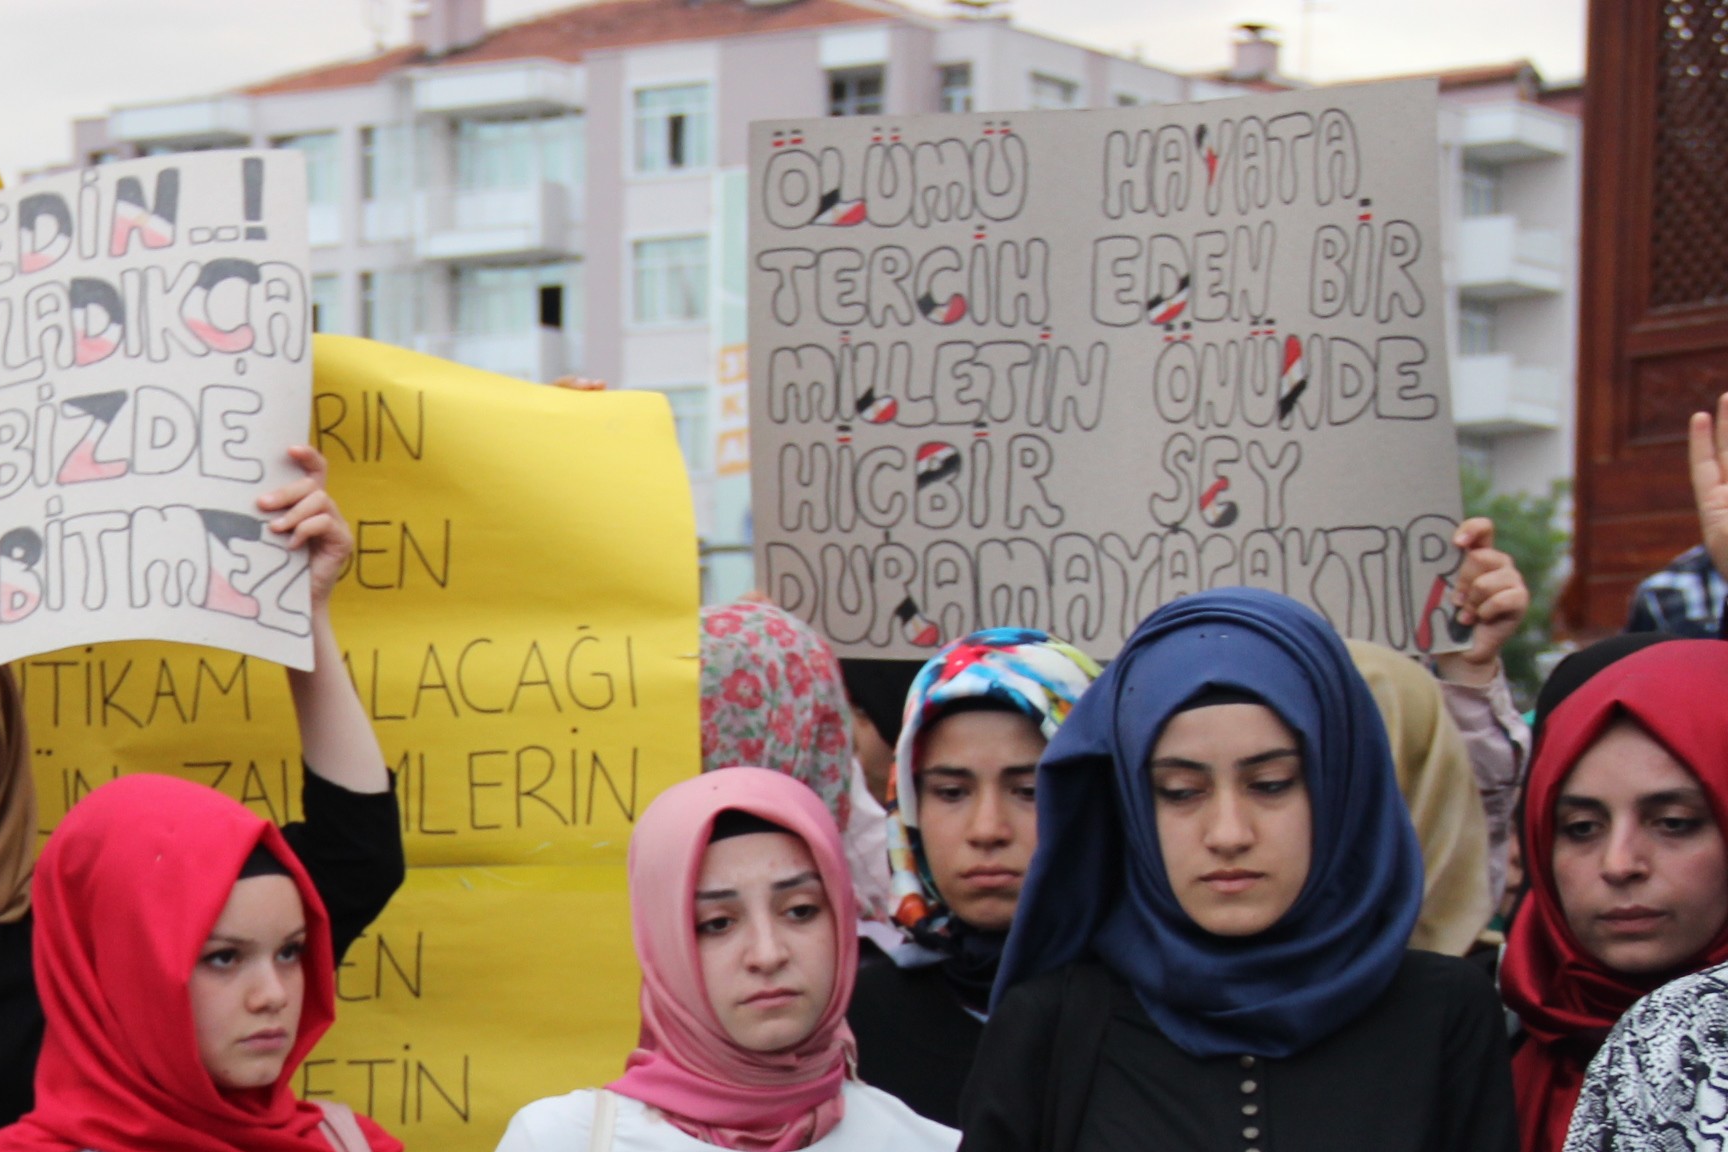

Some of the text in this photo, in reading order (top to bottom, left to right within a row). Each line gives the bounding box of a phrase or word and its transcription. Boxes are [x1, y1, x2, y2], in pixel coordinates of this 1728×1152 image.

[762, 107, 1361, 229] ÖLÜMÜ HAYATA
[756, 198, 1426, 328] TERCİH EDEN BİR
[768, 328, 1109, 433] MİLLETİN
[1153, 319, 1440, 431] ÖNÜNDE
[20, 645, 252, 728] TİKAM
